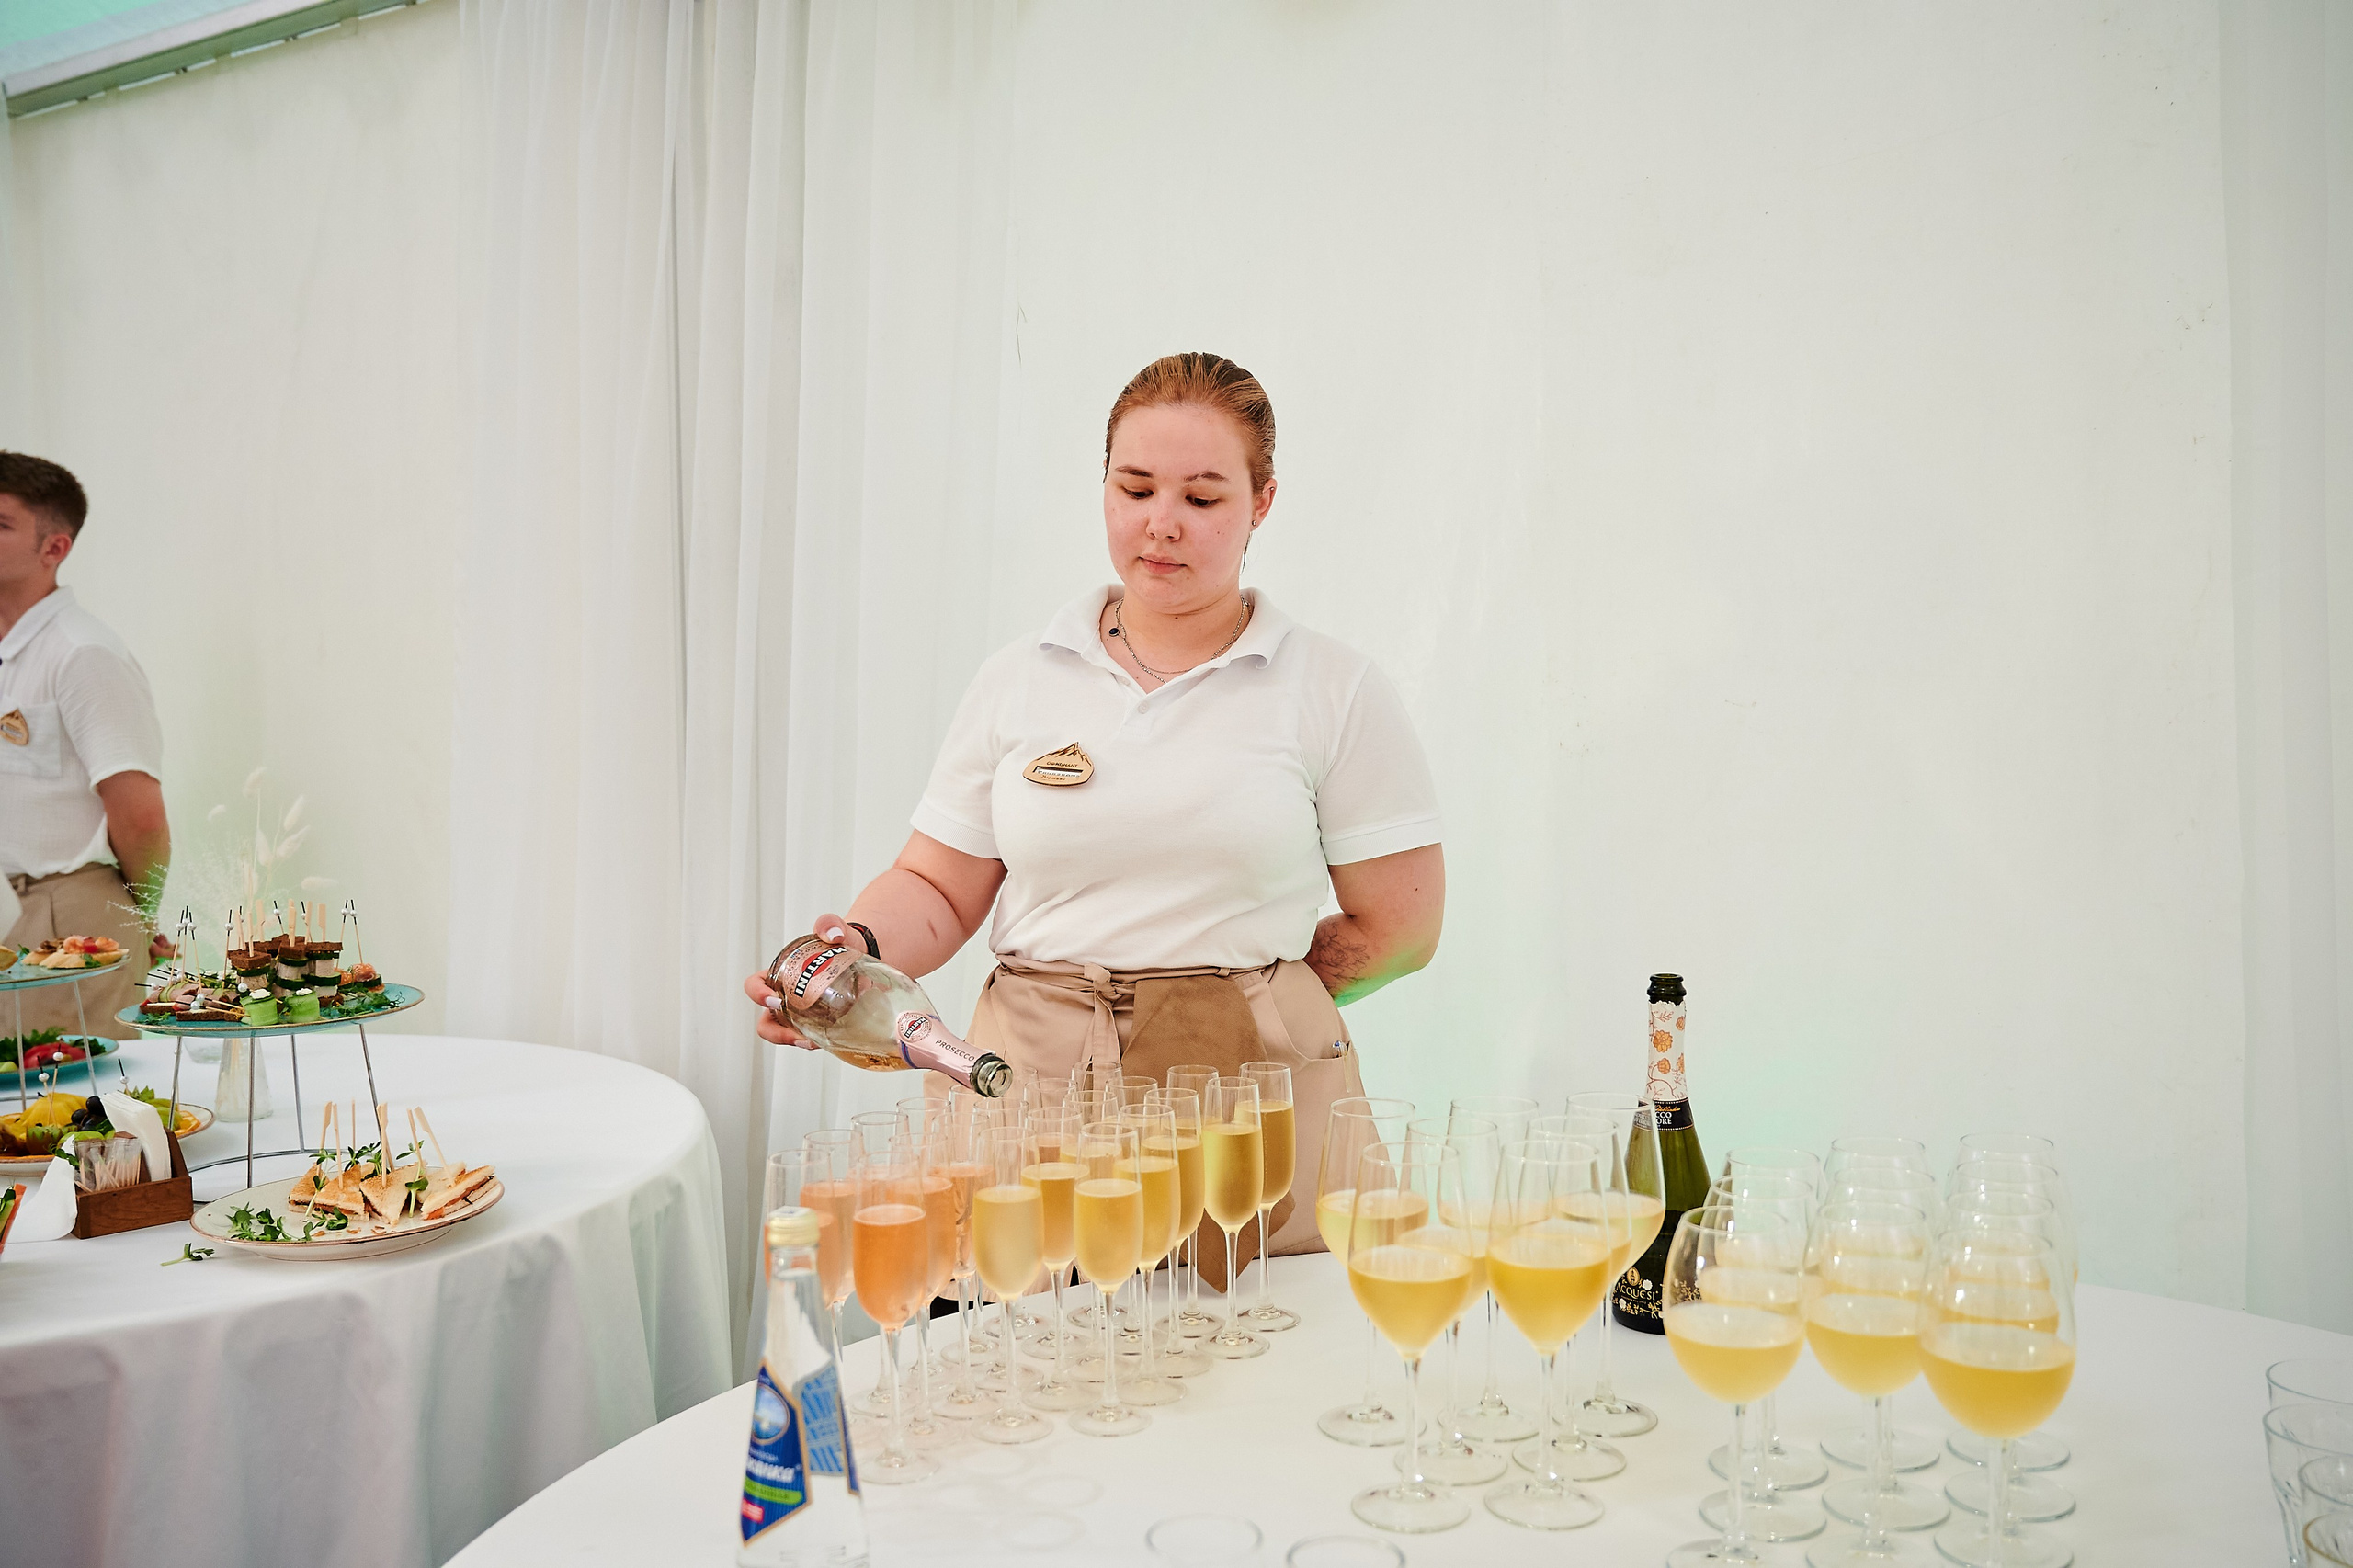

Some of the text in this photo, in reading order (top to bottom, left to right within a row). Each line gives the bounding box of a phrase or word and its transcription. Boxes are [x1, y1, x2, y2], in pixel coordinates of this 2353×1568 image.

[795, 947, 847, 995] MARTINI
[904, 1017, 927, 1038] MARTINI
[935, 1039, 975, 1062] PROSECCO
